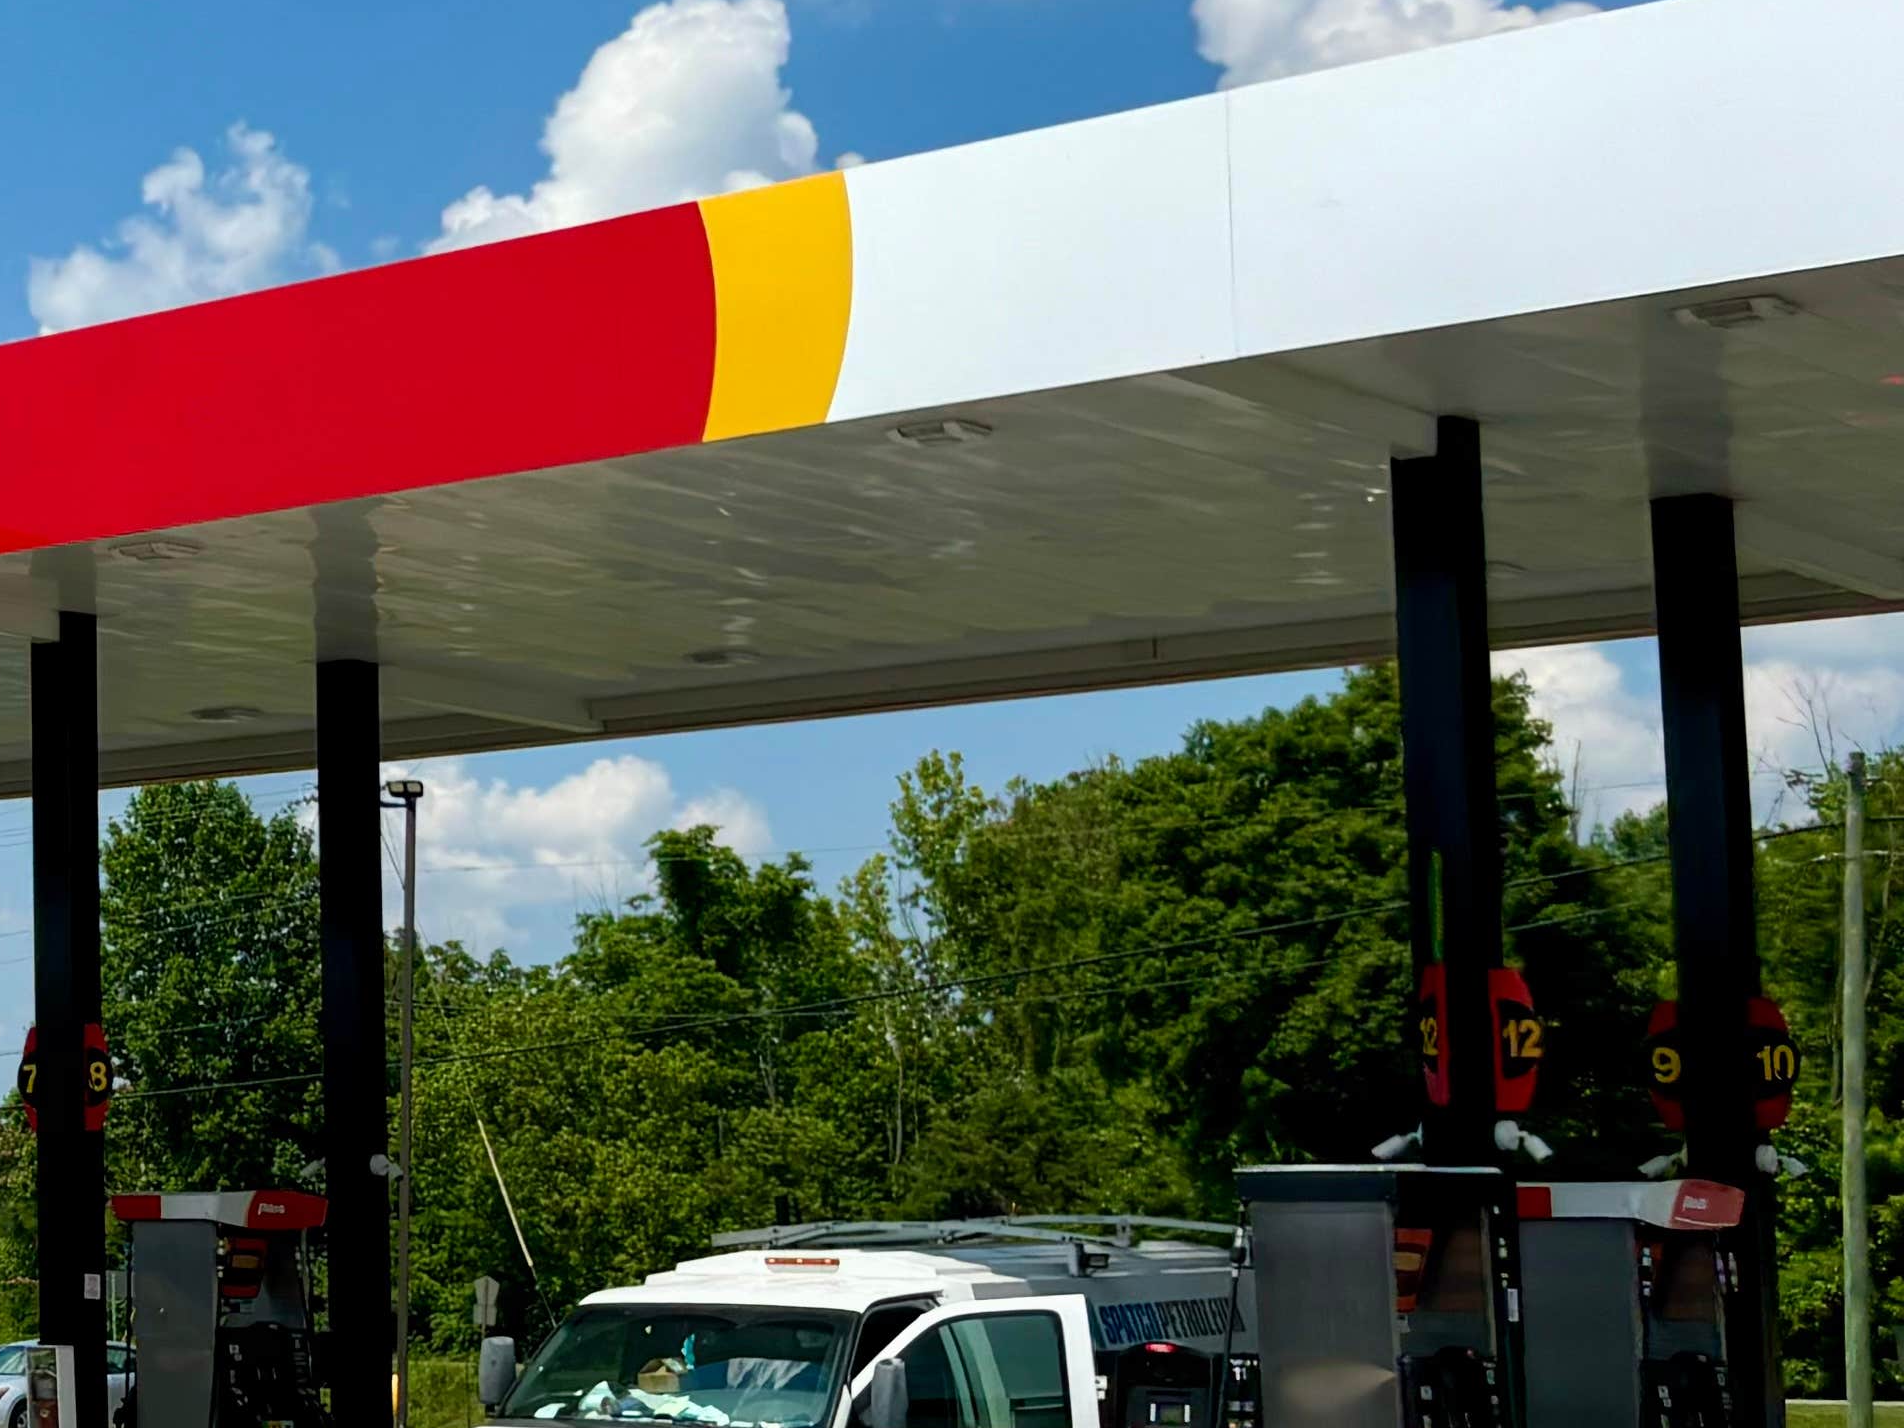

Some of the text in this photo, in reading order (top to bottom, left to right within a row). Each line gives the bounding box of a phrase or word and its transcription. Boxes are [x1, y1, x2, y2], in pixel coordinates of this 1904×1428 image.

[1502, 1019, 1544, 1058] 12
[21, 1064, 37, 1094] 7
[88, 1061, 108, 1092] 8
[1652, 1046, 1682, 1084] 9
[1756, 1044, 1795, 1082] 10
